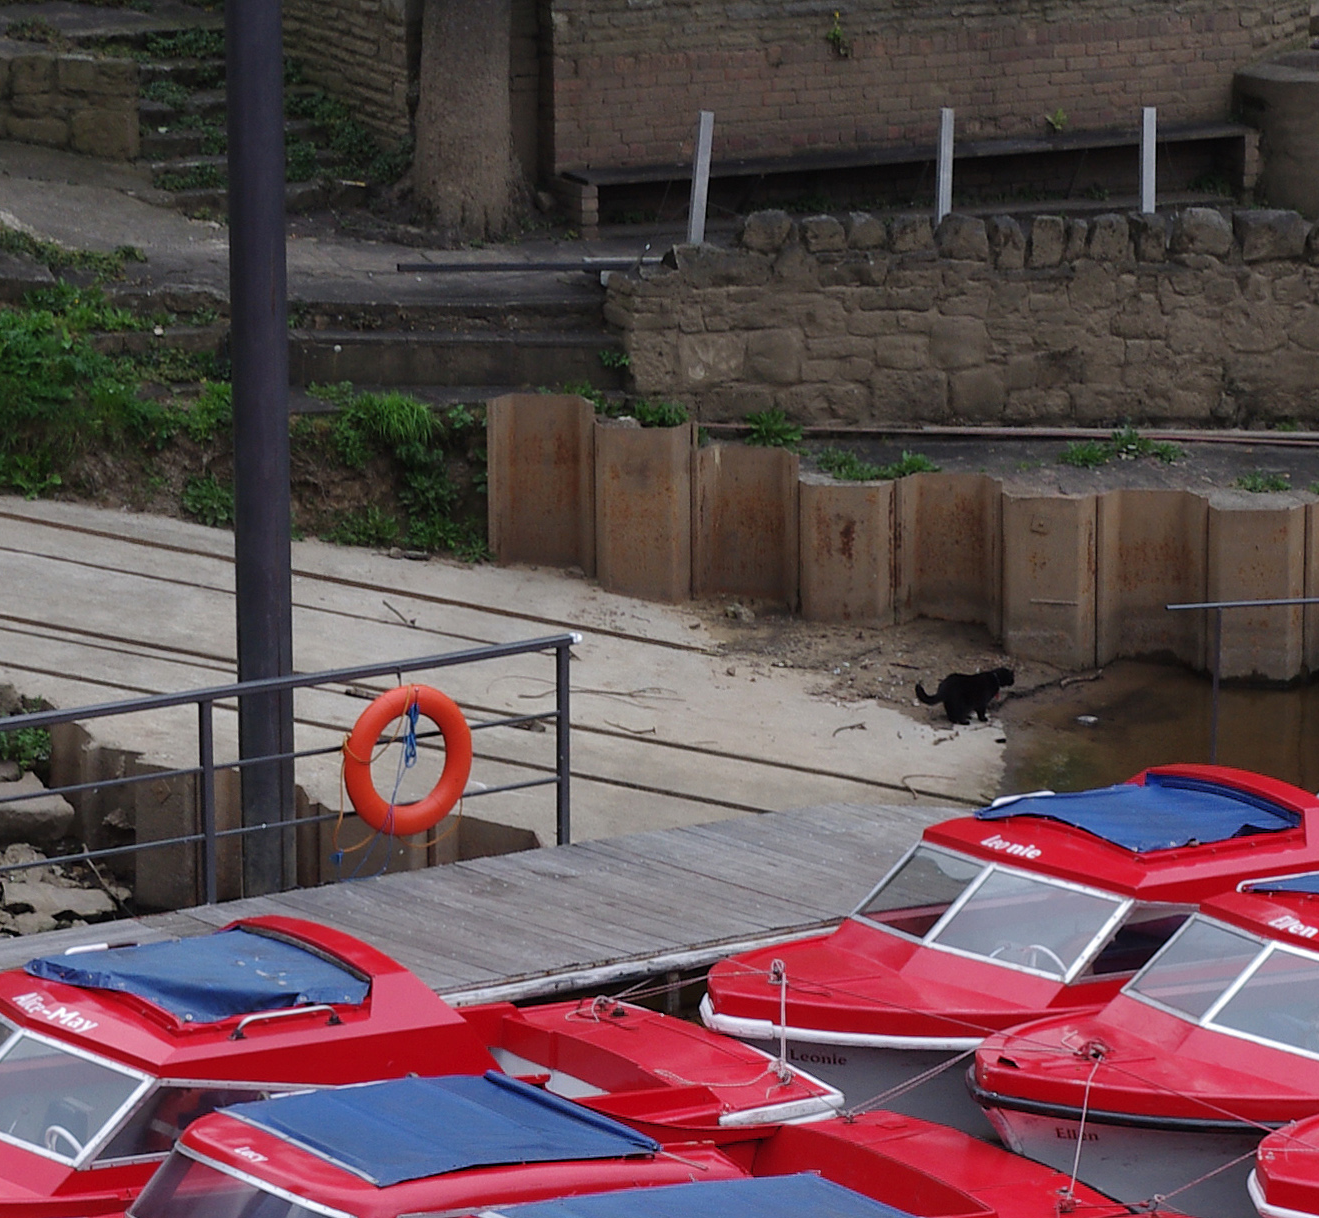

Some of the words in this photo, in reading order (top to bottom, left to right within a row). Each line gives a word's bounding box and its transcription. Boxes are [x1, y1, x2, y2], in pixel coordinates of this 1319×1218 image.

[979, 834, 1043, 859] Leonie
[1267, 914, 1319, 939] Ellen
[790, 1049, 847, 1065] Leonie
